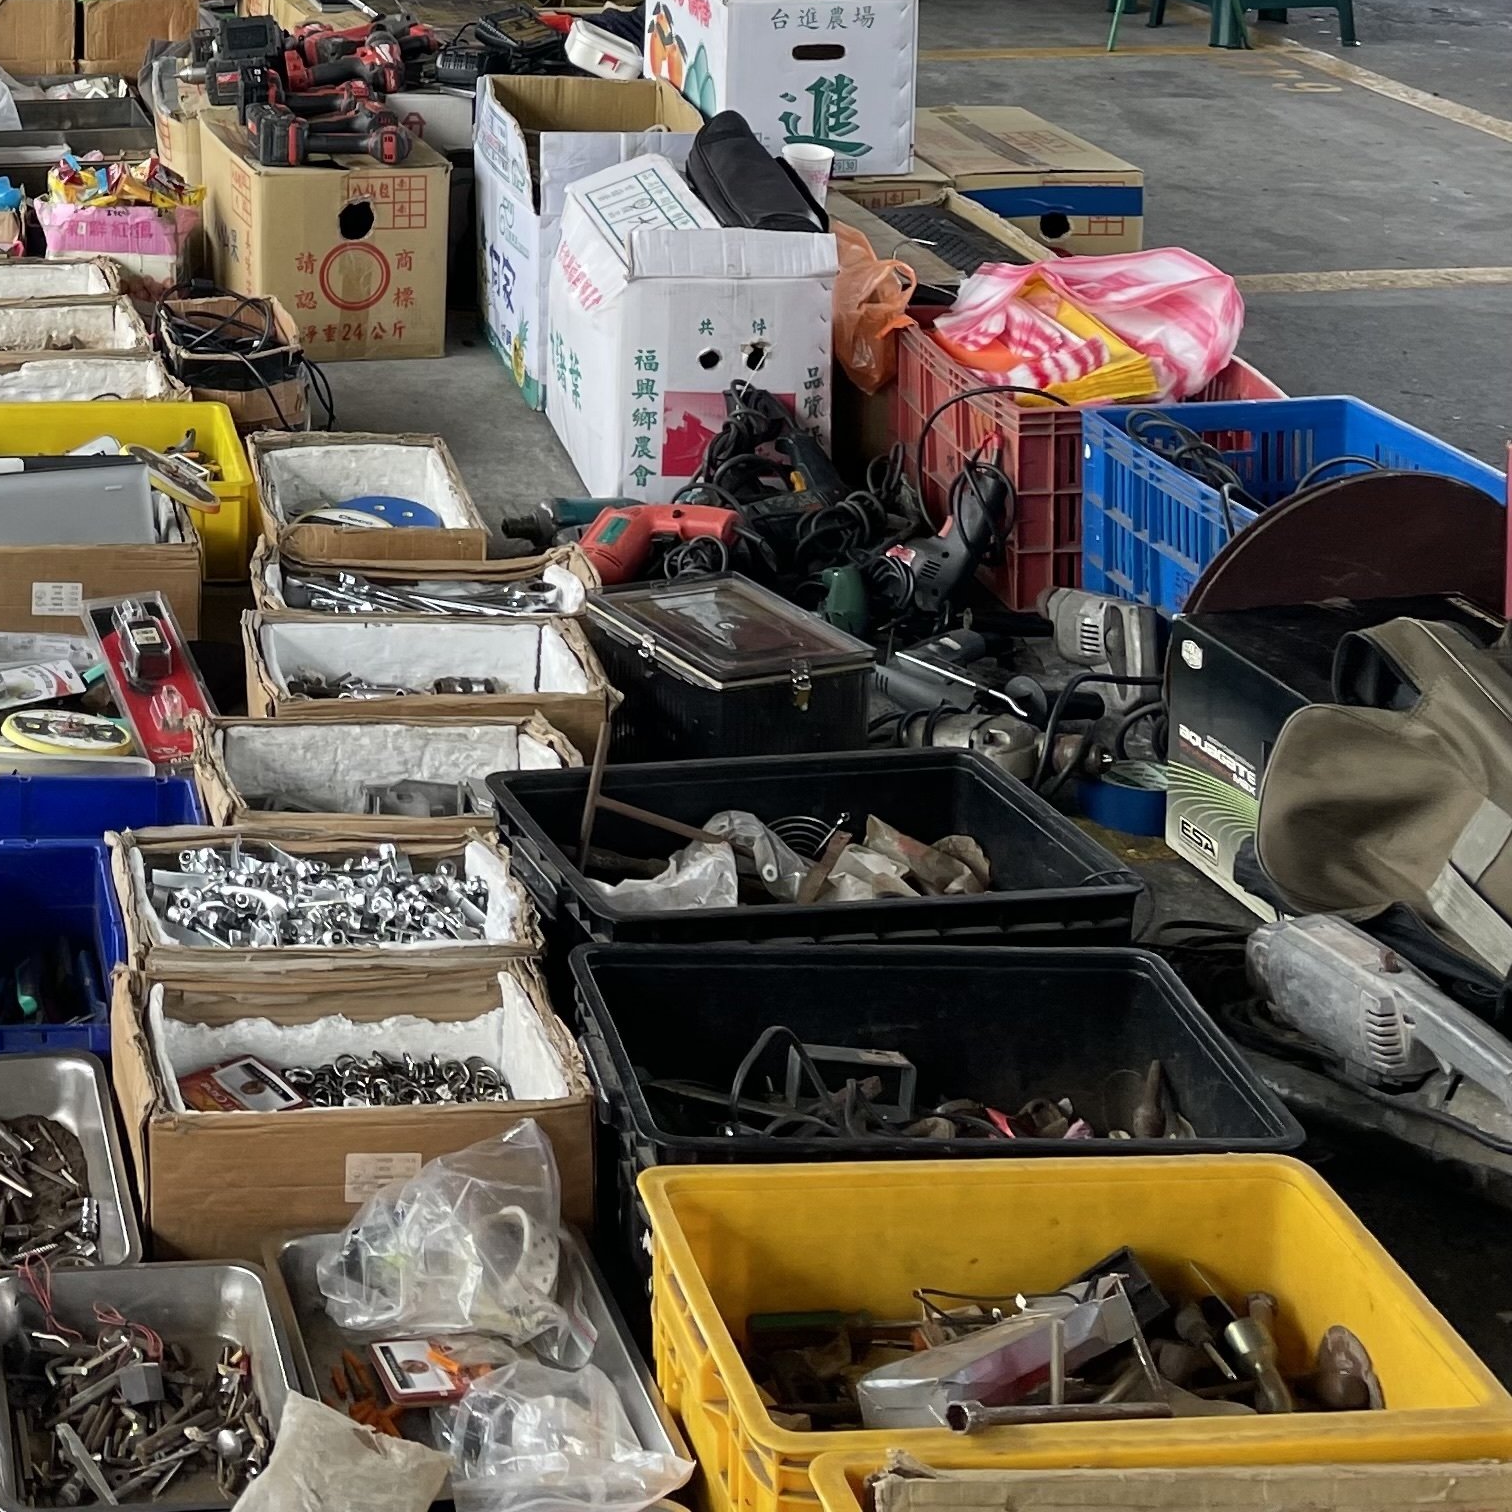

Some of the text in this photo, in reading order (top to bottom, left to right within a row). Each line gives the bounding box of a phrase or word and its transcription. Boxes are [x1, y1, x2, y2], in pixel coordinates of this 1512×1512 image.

[771, 5, 876, 29] 台進農場
[778, 74, 873, 157] 進
[295, 251, 318, 310] 請認
[393, 249, 416, 310] 商標
[698, 318, 715, 336] 共
[629, 349, 660, 488] 福興鄉農會
[1181, 819, 1216, 857] ESA
